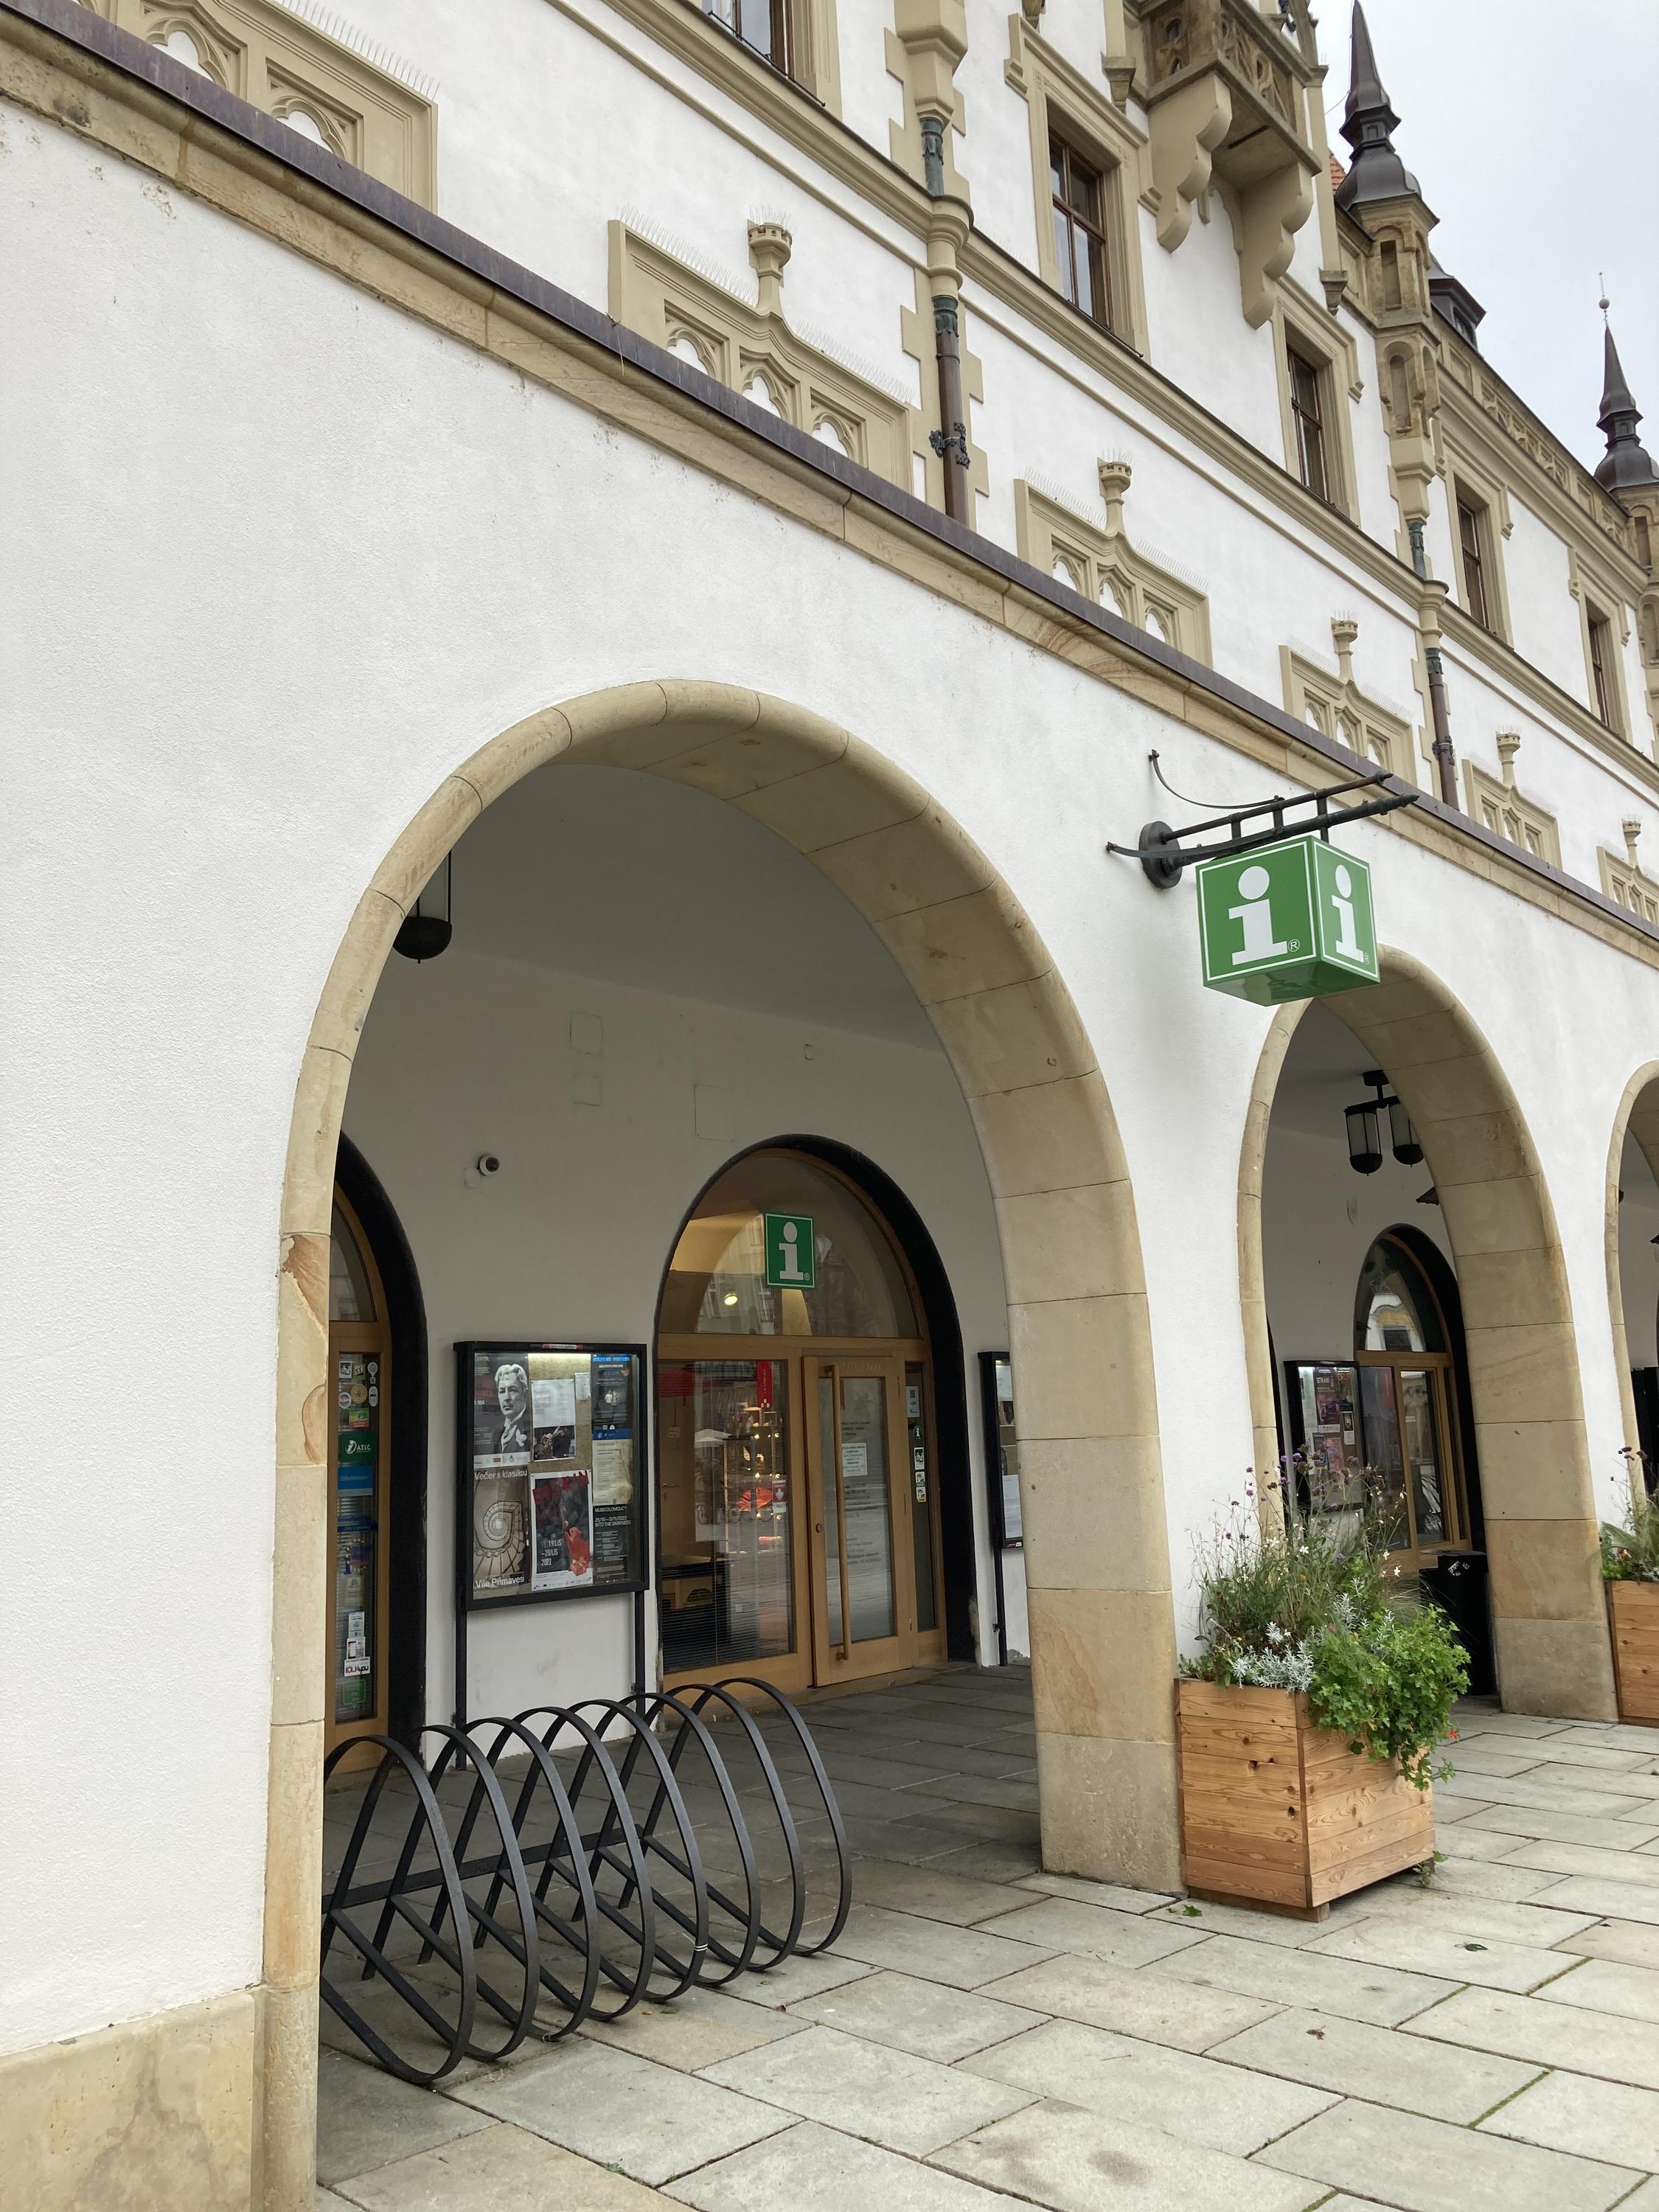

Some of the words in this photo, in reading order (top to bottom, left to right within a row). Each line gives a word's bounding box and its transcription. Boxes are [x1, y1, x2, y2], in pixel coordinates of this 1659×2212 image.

[474, 1471, 495, 1481] Večer
[502, 1470, 528, 1478] klasikou
[540, 1558, 552, 1566] 2022
[492, 1576, 525, 1587] Primavesi
